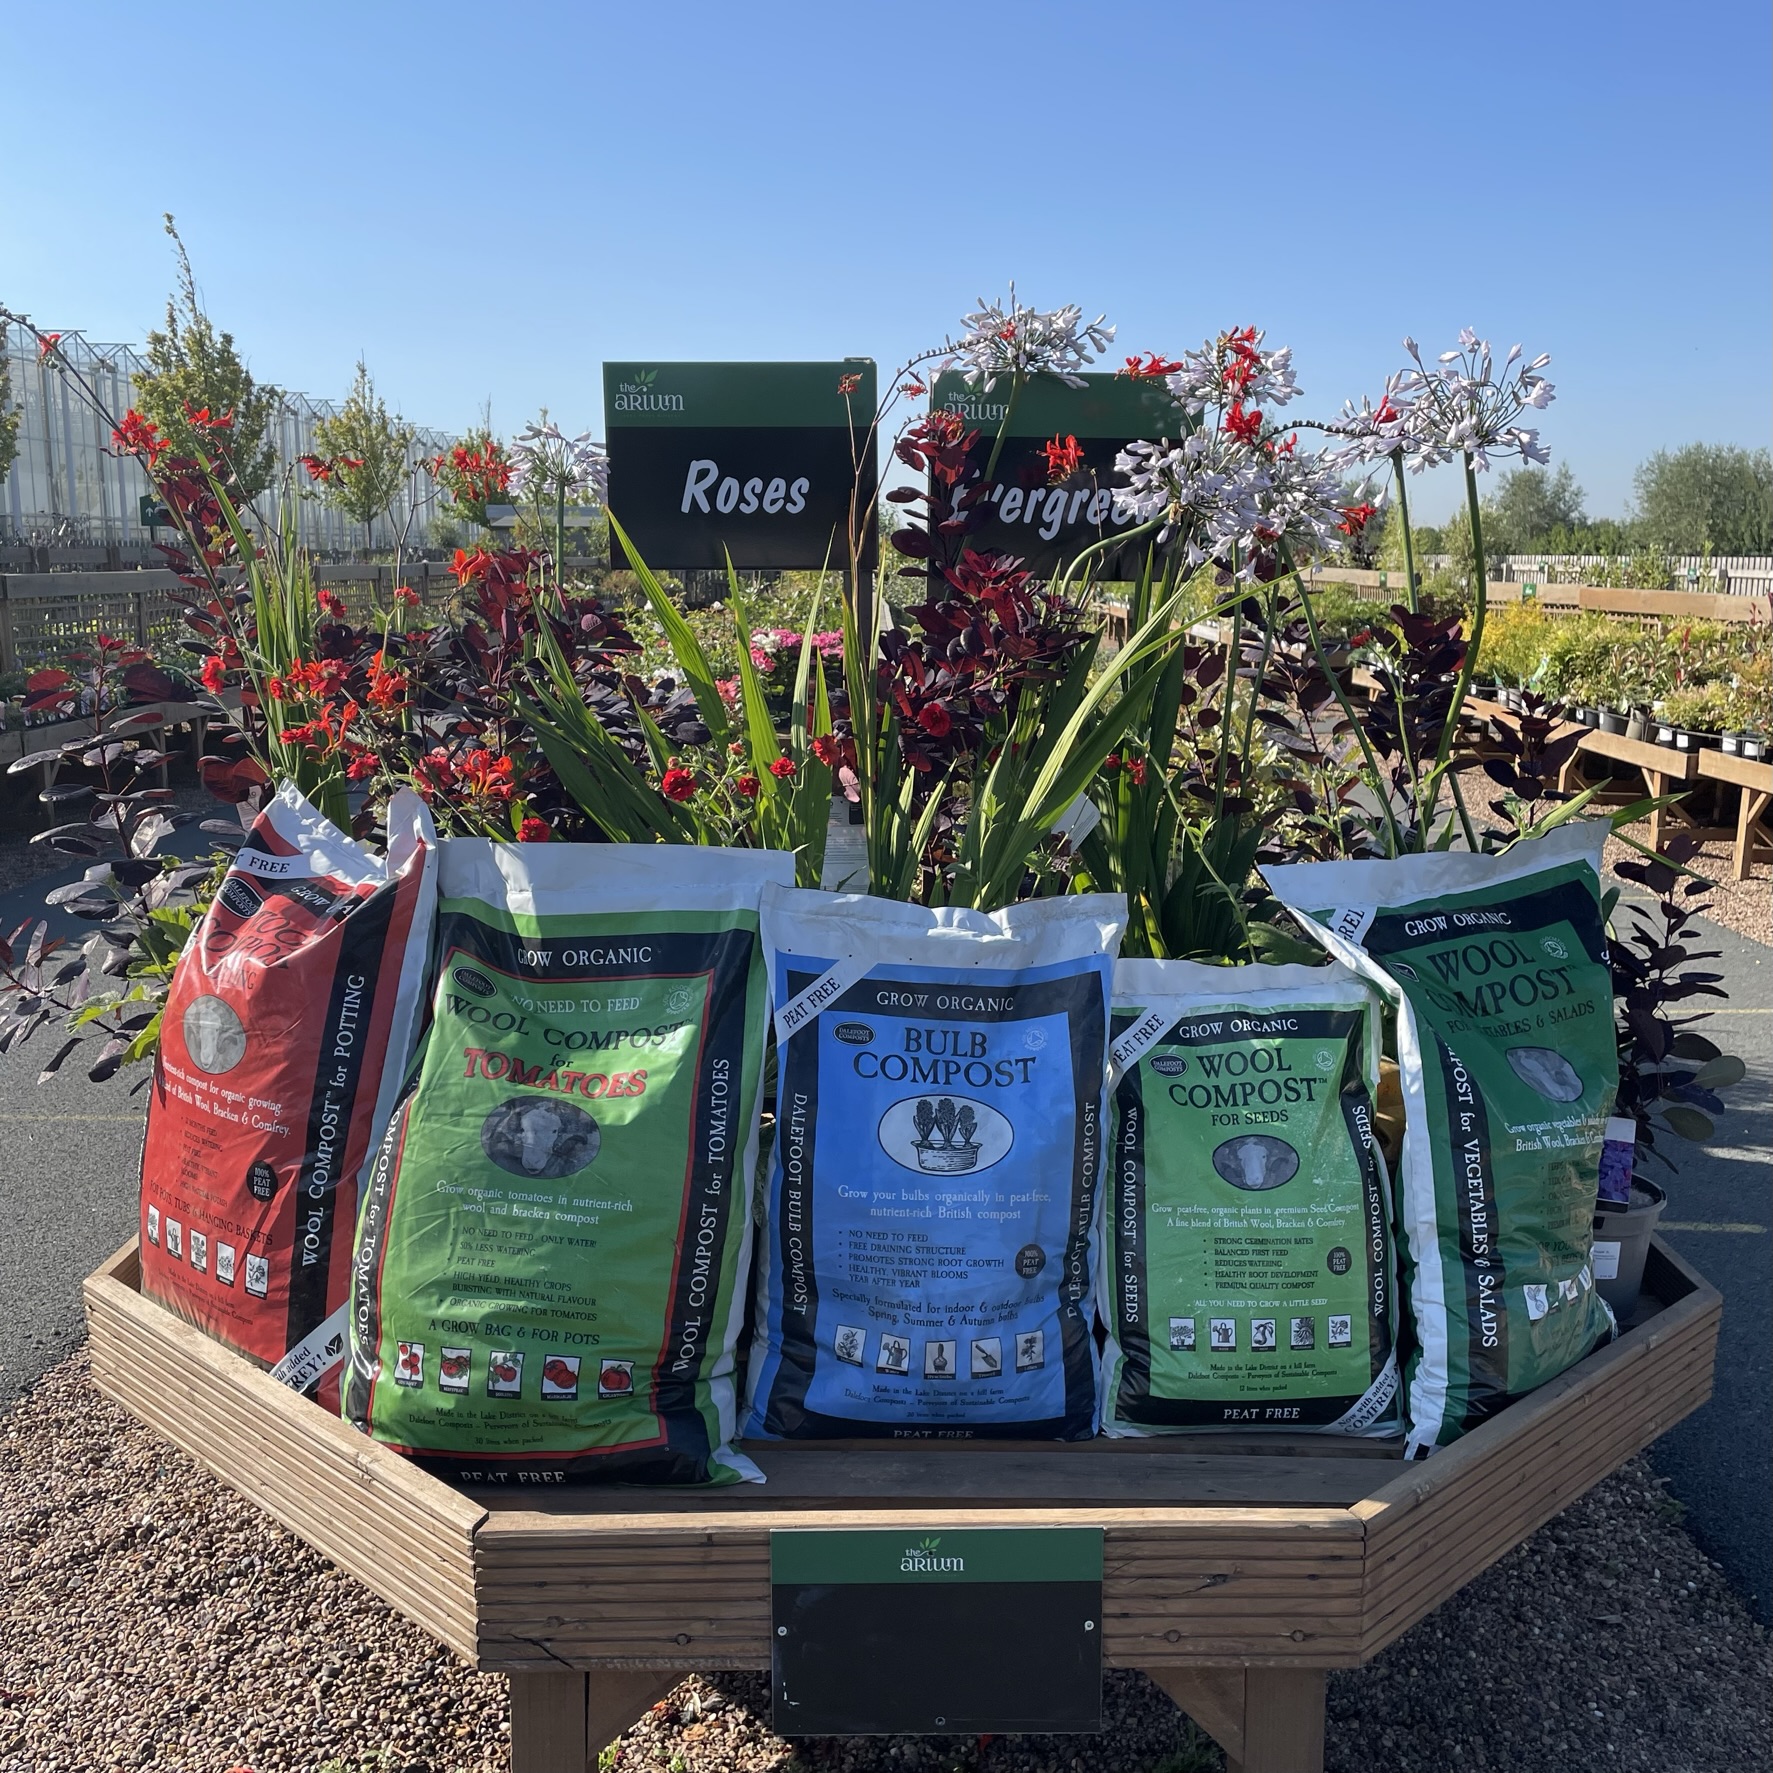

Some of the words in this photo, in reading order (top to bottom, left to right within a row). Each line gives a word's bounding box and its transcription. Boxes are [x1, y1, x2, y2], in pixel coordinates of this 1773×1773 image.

[619, 382, 647, 392] the
[681, 459, 810, 514] Roses
[249, 856, 290, 873] FREE
[291, 886, 331, 906] GROW
[1405, 915, 1449, 937] GROW
[1454, 911, 1512, 927] ORGANIC
[518, 948, 552, 967] GROW
[563, 947, 652, 966] ORGANIC
[1426, 939, 1536, 984] WOOL
[537, 1000, 575, 1014] NEED
[581, 1000, 601, 1013] TO
[782, 1007, 806, 1029] PEAT
[808, 976, 841, 1008] FREE
[876, 990, 929, 1008] GROW
[937, 995, 1014, 1012] ORGANIC
[333, 975, 365, 1058] POTTING
[445, 993, 529, 1035] WOOL
[1536, 1015, 1544, 1028] &
[1549, 1000, 1595, 1025] SALADS
[1135, 1014, 1165, 1046] FREE
[1179, 1022, 1224, 1039] GROW
[1230, 1019, 1299, 1032] ORGANIC
[904, 1027, 988, 1059] BULB
[550, 1053, 574, 1068] for
[853, 1052, 1037, 1088] COMPOST
[1196, 1048, 1292, 1079] WOOL
[330, 1065, 347, 1088] for
[463, 1048, 648, 1099] TOMATOES
[210, 1081, 219, 1095] for
[221, 1090, 245, 1104] organic
[708, 1058, 730, 1164] TOMATOES
[1212, 1114, 1240, 1126] FOR
[1244, 1110, 1289, 1125] SEEDS
[1460, 1112, 1475, 1132] for
[788, 1092, 808, 1185] DALEFOOT
[1124, 1106, 1137, 1154] WOOL
[1082, 1102, 1096, 1189] COMPOST
[1516, 1138, 1542, 1151] British
[254, 1177, 271, 1187] PEAT
[254, 1186, 270, 1197] FREE
[705, 1173, 722, 1195] for
[436, 1180, 464, 1194] Grow
[468, 1188, 503, 1201] organic
[508, 1191, 553, 1203] tomatoes
[558, 1195, 567, 1205] in
[572, 1197, 633, 1212] nutrient-rich
[838, 1185, 869, 1200] Grow
[873, 1190, 896, 1202] your
[901, 1189, 930, 1202] bulbs
[935, 1190, 990, 1205] organically
[995, 1192, 1005, 1202] in
[1463, 1138, 1490, 1262] VEGETABLES
[174, 1197, 191, 1214] TUBS
[200, 1210, 233, 1233] HANGING
[370, 1204, 380, 1226] for
[463, 1202, 485, 1213] wool
[490, 1204, 507, 1215] and
[512, 1205, 550, 1220] bracken
[555, 1212, 599, 1227] compost
[788, 1189, 801, 1232] BULB
[870, 1205, 932, 1219] nutrient-rich
[938, 1205, 972, 1219] British
[977, 1209, 1021, 1223] compost
[1152, 1203, 1172, 1214] Grow
[1212, 1205, 1238, 1216] organic
[1240, 1205, 1262, 1216] plants
[1275, 1205, 1308, 1217] premium
[1223, 1218, 1248, 1228] British
[1276, 1217, 1306, 1228] Bracken
[302, 1207, 324, 1267] WOOL
[462, 1226, 475, 1235] NO
[478, 1228, 498, 1238] NEED
[501, 1231, 512, 1239] TO
[515, 1232, 534, 1241] FEED
[541, 1235, 565, 1245] ONLY
[849, 1230, 863, 1239] NO
[866, 1231, 888, 1241] NEED
[891, 1232, 904, 1242] TO
[907, 1232, 929, 1242] FEED
[688, 1203, 718, 1307] COMPOST
[849, 1241, 868, 1251] FREE
[870, 1243, 913, 1254] DRAINING
[915, 1245, 967, 1256] STRUCTURE
[1124, 1251, 1136, 1268] for
[457, 1256, 475, 1266] PEAT
[478, 1258, 496, 1268] FREE
[849, 1253, 895, 1265] PROMOTES
[898, 1256, 935, 1267] STRONG
[938, 1257, 964, 1267] ROOT
[966, 1258, 1005, 1268] GROWTH
[453, 1272, 475, 1281] HIGH
[504, 1277, 541, 1289] HEALTHY
[544, 1281, 572, 1291] CROPS
[789, 1237, 808, 1316] COMPOST
[849, 1274, 869, 1286] YEAR
[872, 1276, 897, 1287] AFTER
[899, 1278, 921, 1288] YEAR
[891, 1267, 929, 1278] VIBRANT
[931, 1269, 969, 1279] BLOOMS
[358, 1235, 376, 1345] TOMATOES
[453, 1284, 492, 1294] BURSTING
[495, 1288, 516, 1297] WITH
[519, 1291, 555, 1303] NATURAL
[558, 1295, 597, 1306] FLAVOUR
[1250, 1282, 1279, 1290] QUALITY
[1374, 1268, 1384, 1317] WOOL
[450, 1298, 486, 1310] ORGANIC
[489, 1302, 528, 1314] GROWING
[531, 1307, 548, 1317] FOR
[550, 1310, 597, 1322] TOMATOES
[874, 1295, 922, 1313] formulated
[926, 1302, 941, 1314] for
[945, 1302, 976, 1314] indoor
[1125, 1275, 1139, 1323] SEEDS
[903, 1314, 945, 1328] Summer
[1478, 1274, 1498, 1348] SALADS
[441, 1320, 480, 1335] GROW
[484, 1324, 512, 1337] BAG
[531, 1328, 558, 1342] FOR
[564, 1332, 600, 1345] POTS
[672, 1316, 701, 1373] WOOL
[286, 1347, 311, 1373] added
[1372, 1374, 1389, 1397] added
[1224, 1408, 1260, 1420] PEAT
[1266, 1408, 1300, 1419] FREE
